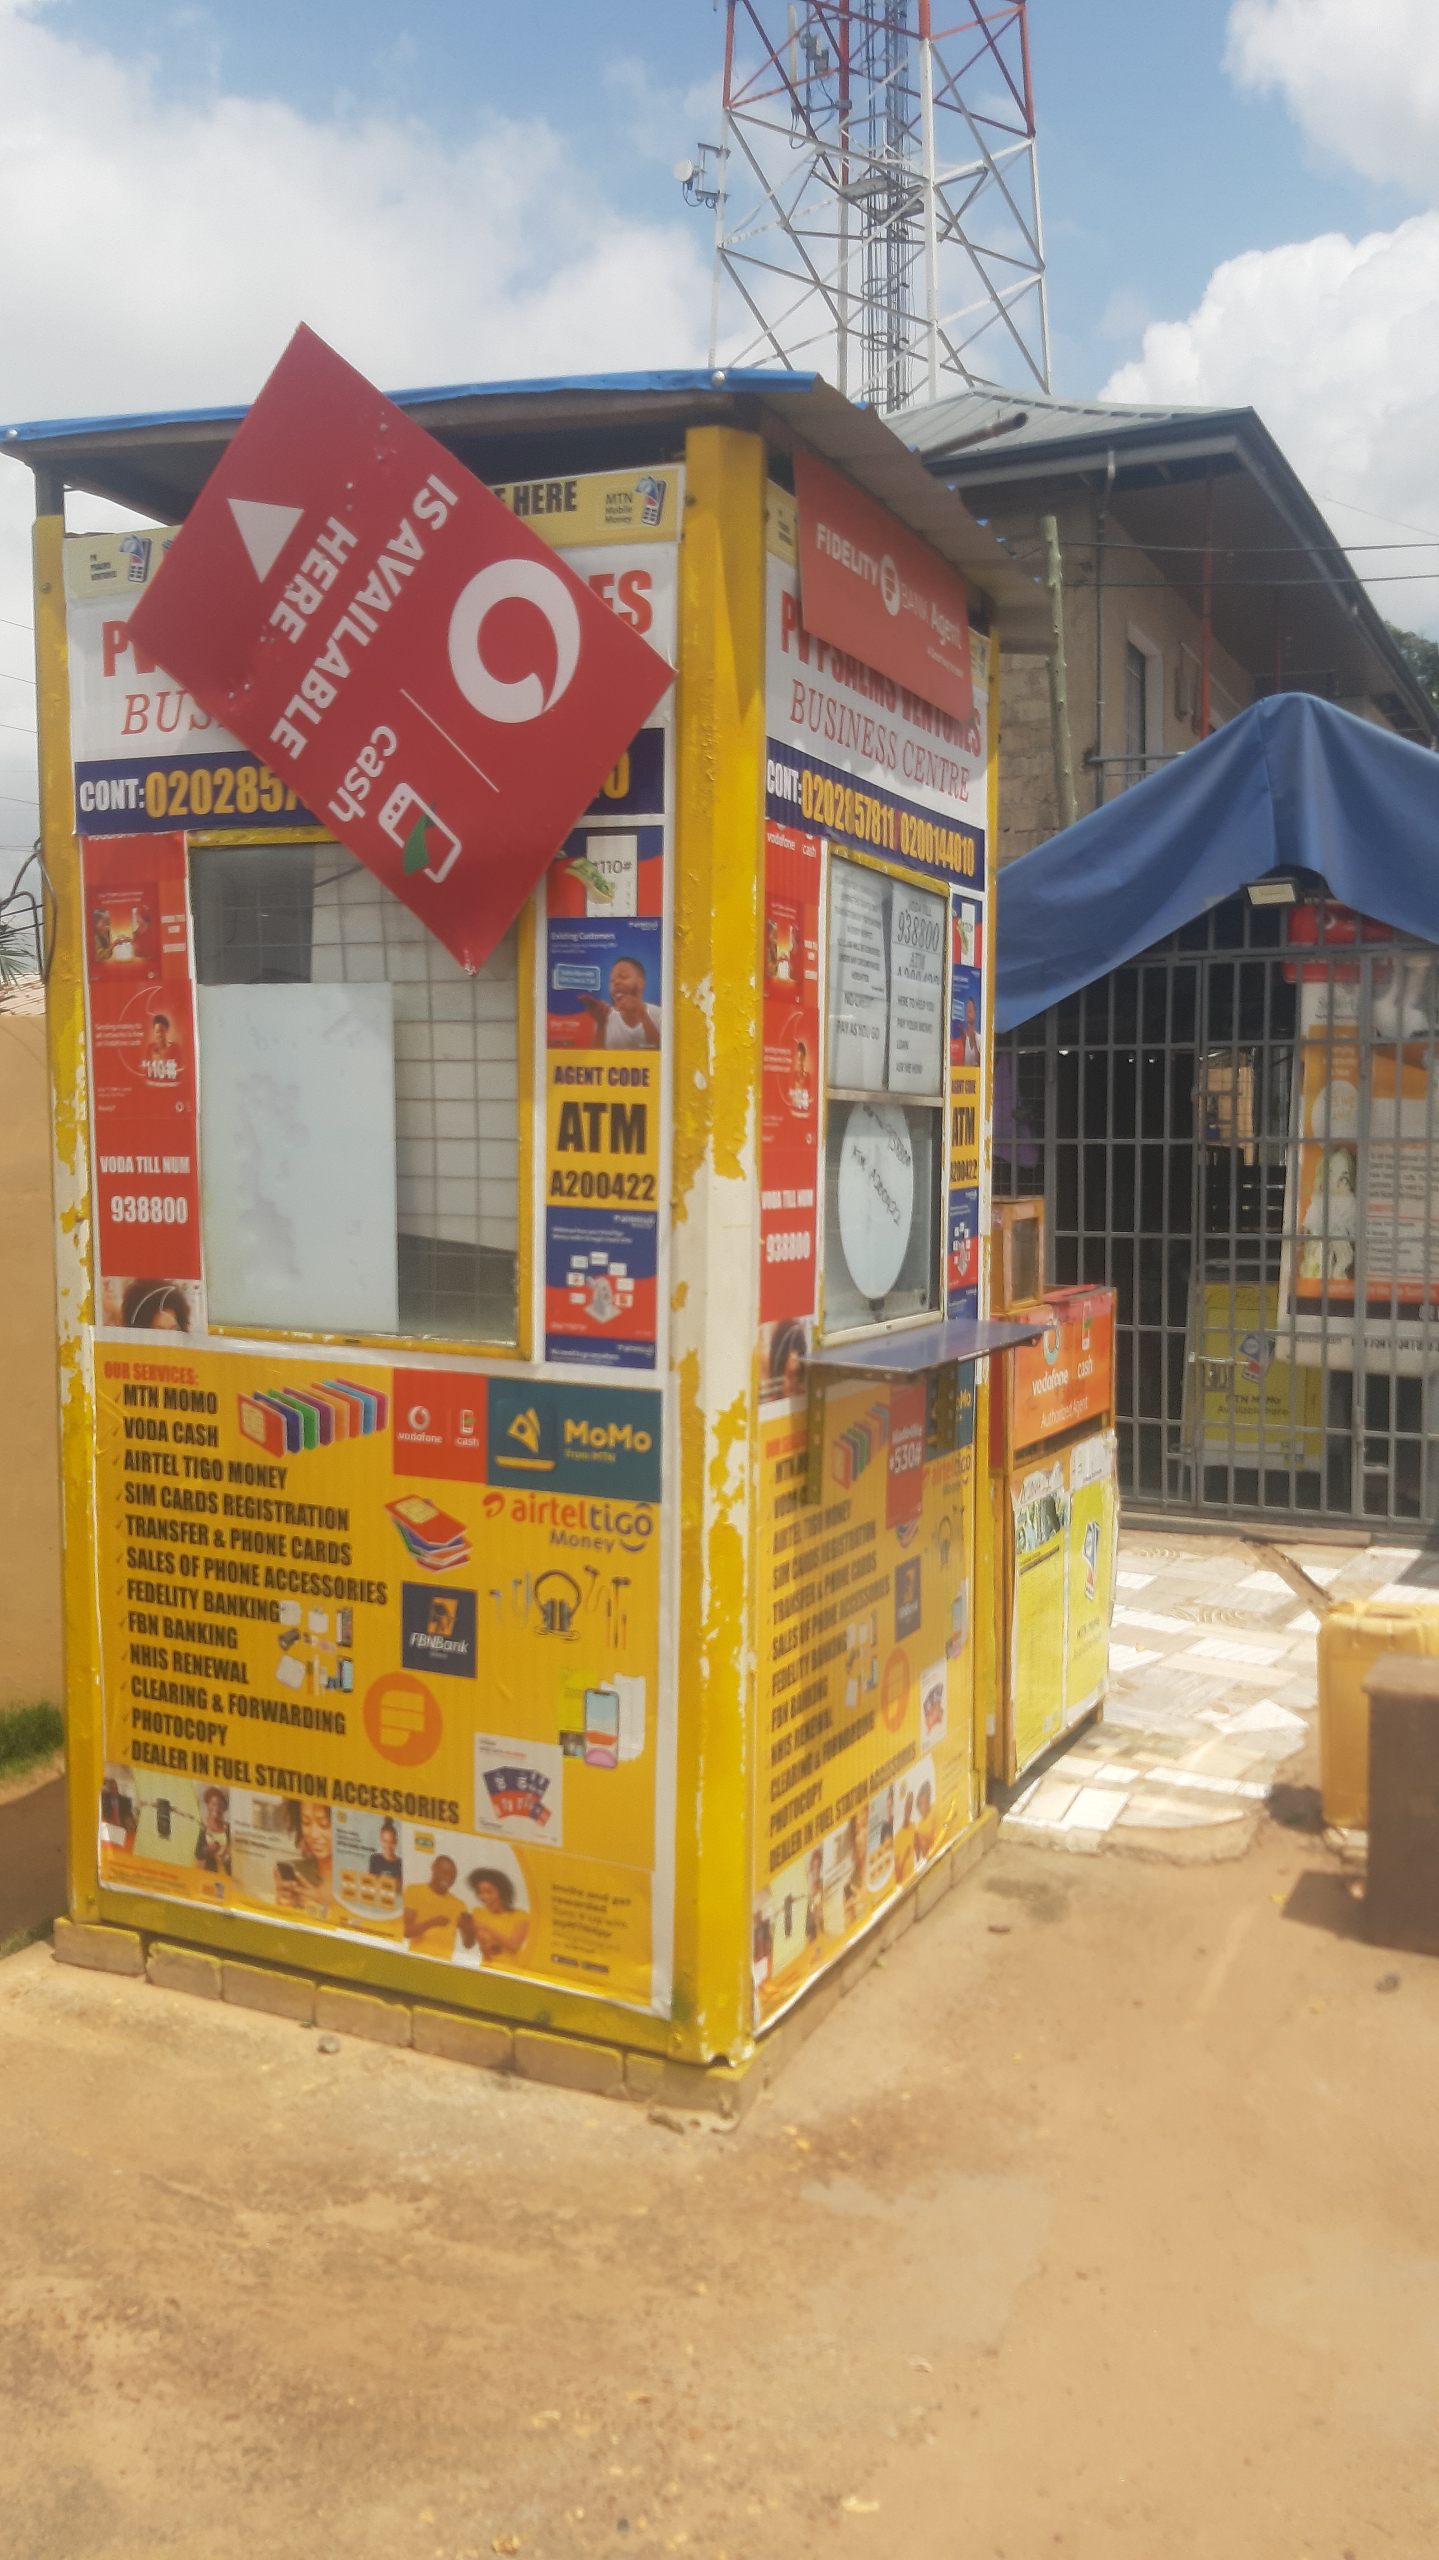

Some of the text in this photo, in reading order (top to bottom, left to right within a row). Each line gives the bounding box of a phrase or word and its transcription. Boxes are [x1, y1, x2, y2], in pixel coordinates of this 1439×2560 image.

[412, 473, 460, 532] IS
[513, 480, 577, 517] HERE
[605, 493, 633, 505] MTN
[605, 505, 633, 515] Mobile
[605, 515, 632, 524] Money
[816, 522, 880, 587] FIDELITY
[269, 516, 360, 644] HERE
[269, 517, 425, 760] AVAILABLE
[790, 678, 970, 803] BUSINESS CENTRE
[327, 726, 398, 823] cash
[766, 759, 802, 806] CONT:
[79, 778, 146, 812] CONT:
[766, 832, 796, 851] vodafone
[802, 844, 817, 858] cash
[897, 908, 940, 953] 938800
[554, 1065, 651, 1088] AGENT CODE
[557, 1100, 648, 1155] ATM
[951, 1106, 976, 1147] ATM
[100, 1155, 190, 1175] VODA TILL NUM
[551, 1169, 656, 1202] A200422
[110, 1195, 189, 1225] 938800
[766, 1230, 811, 1264] 938800
[104, 1361, 200, 1386] OUR SERVICES:
[1031, 1366, 1069, 1396] vodafone
[1077, 1355, 1094, 1379] cash
[123, 1383, 219, 1415] MTN MOMO
[123, 1416, 219, 1448] VODA CASH
[397, 1430, 443, 1445] vodafone
[455, 1435, 480, 1448] cash
[564, 1418, 652, 1453] MoMo
[124, 1449, 289, 1490] AIRTEL TIGO MONEY
[124, 1481, 350, 1532] SIM CARDS REGISTRATION
[510, 1492, 654, 1537] airteltigo
[125, 1514, 353, 1566] TRANSFER & PHONE CARDS
[551, 1528, 615, 1554] Money
[126, 1546, 389, 1606] SALES OF PHONE ACCESSORIES
[127, 1578, 281, 1624] FEDELITY BANKING
[128, 1610, 238, 1650] FBN BANKING
[410, 1632, 469, 1655] FBNBank
[130, 1643, 249, 1686] NHIS RENEWAL
[131, 1674, 347, 1737] CLEARING & FORWARDING
[131, 1706, 228, 1747] PHOTOCOPY
[131, 1738, 460, 1825] DEALER IN FUEL STATION ACCESSORIES
